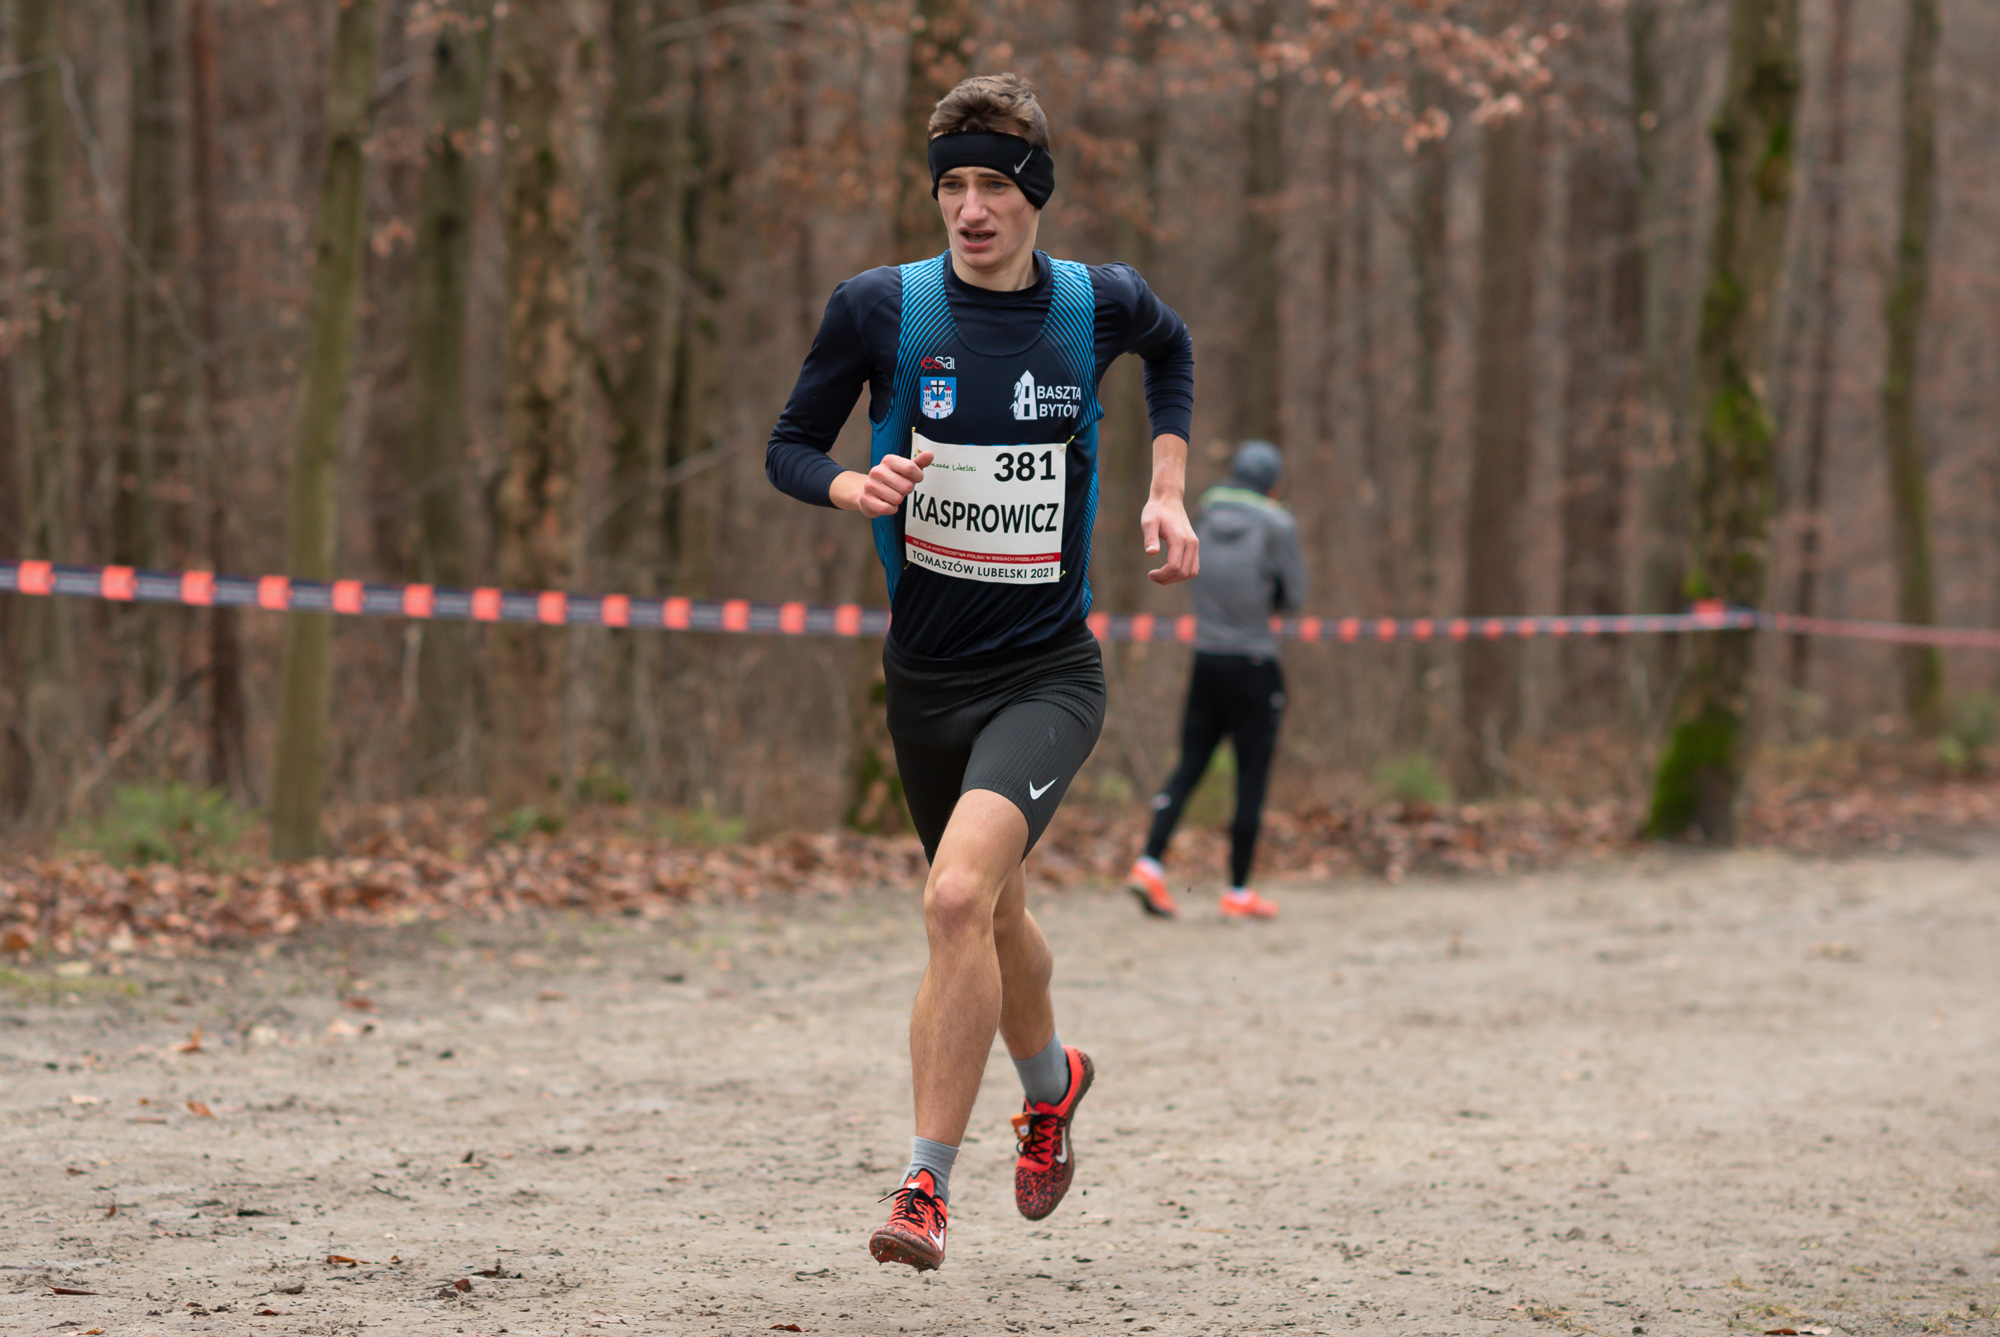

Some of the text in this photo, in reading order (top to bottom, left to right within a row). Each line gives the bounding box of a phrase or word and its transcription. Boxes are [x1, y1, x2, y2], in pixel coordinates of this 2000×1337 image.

[1036, 385, 1082, 400] BASZTA
[1039, 401, 1080, 419] BYTÓW
[952, 463, 977, 472] Lubelski
[993, 450, 1056, 482] 381
[912, 490, 1059, 533] KASPROWICZ
[912, 550, 1054, 579] TOMASZÓW LUBELSKI 2021
